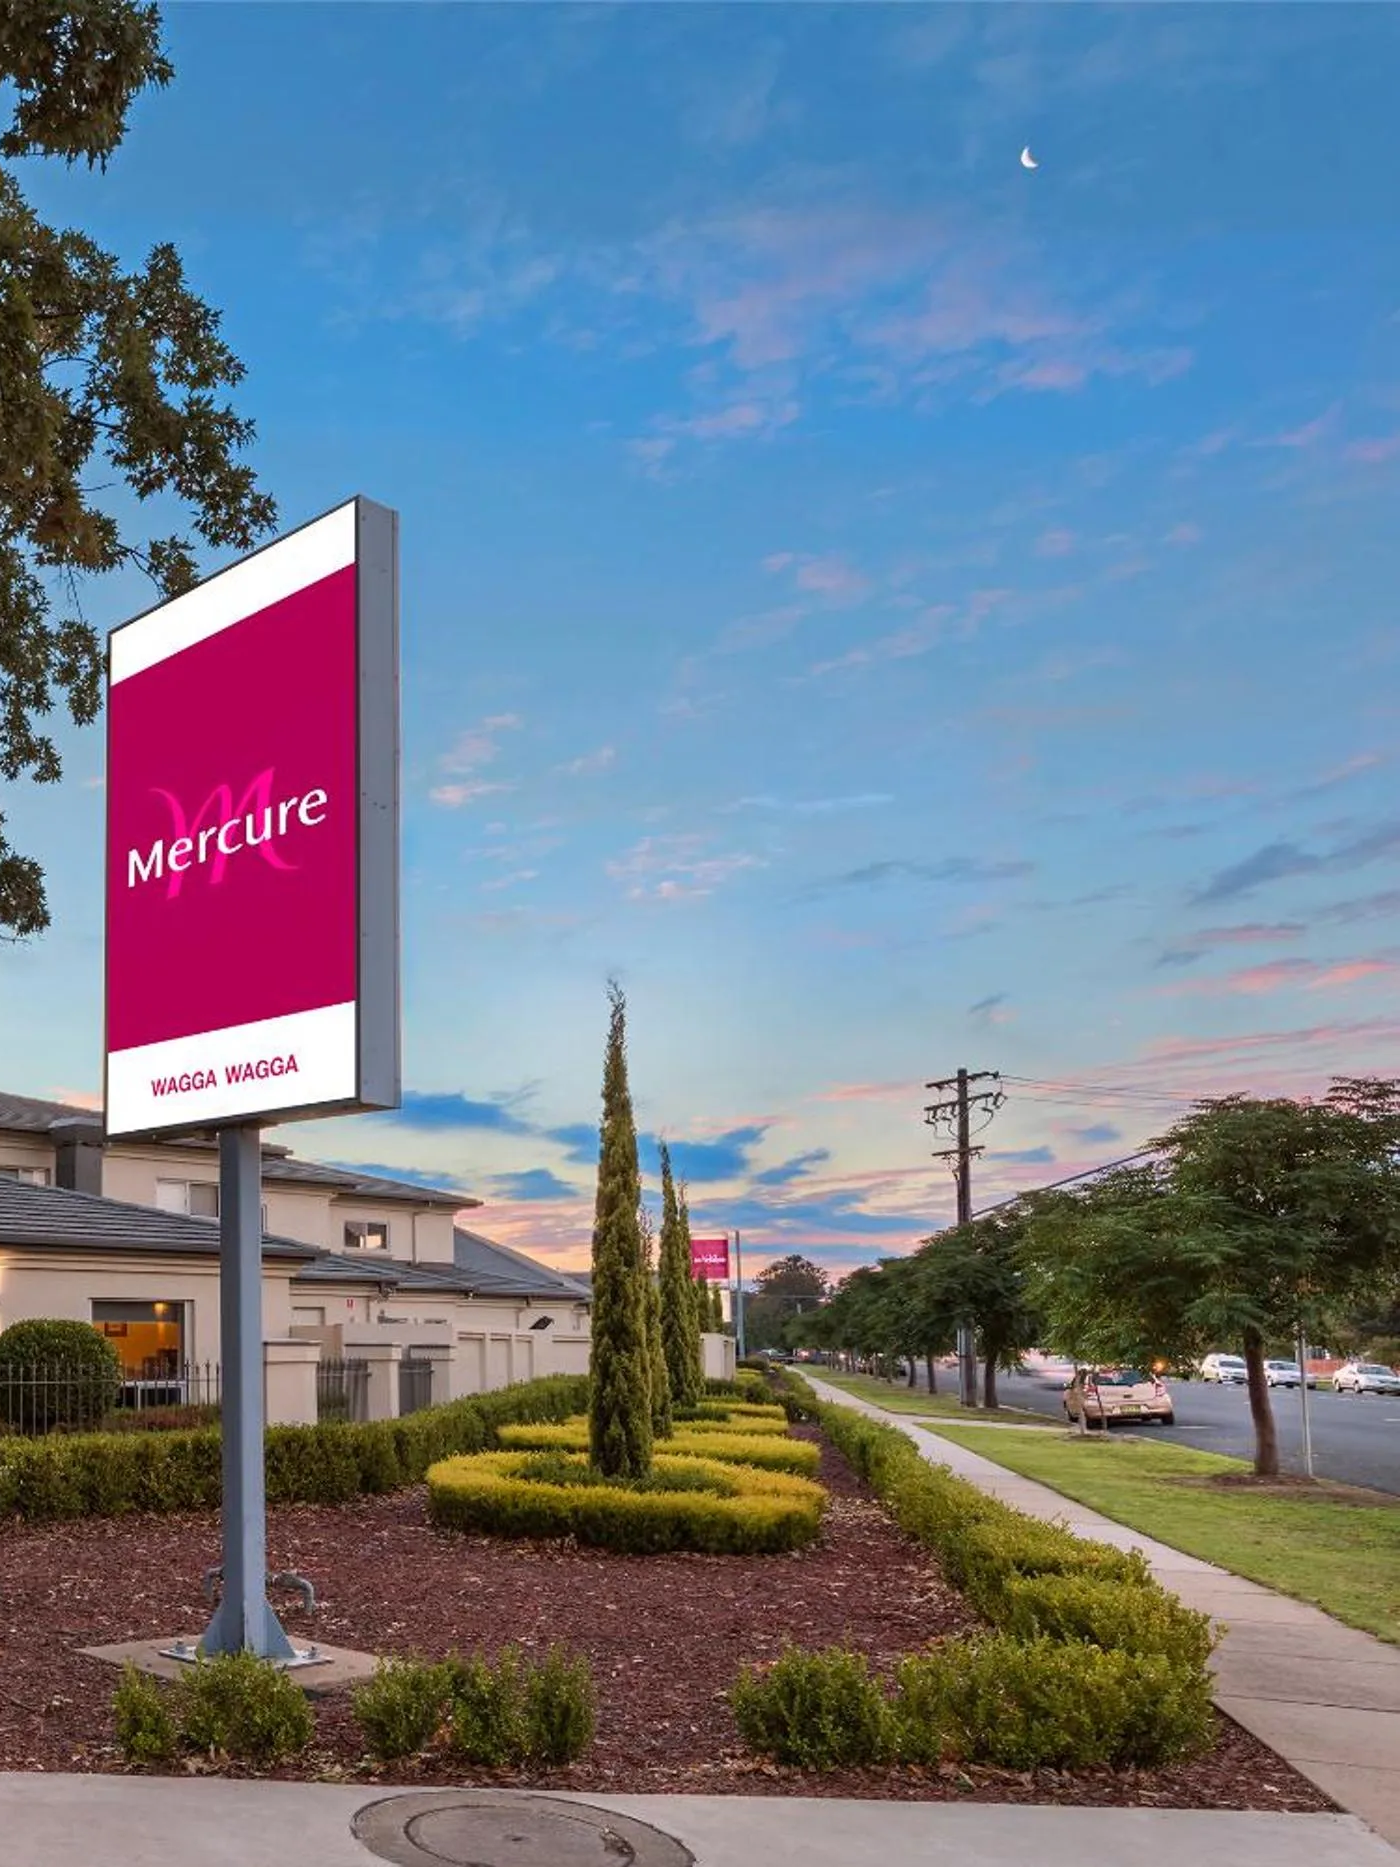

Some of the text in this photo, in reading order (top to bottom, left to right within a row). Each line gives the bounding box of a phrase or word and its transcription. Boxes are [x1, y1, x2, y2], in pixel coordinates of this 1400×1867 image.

[127, 788, 328, 888] Mercure
[150, 1054, 300, 1097] WAGGA WAGGA
